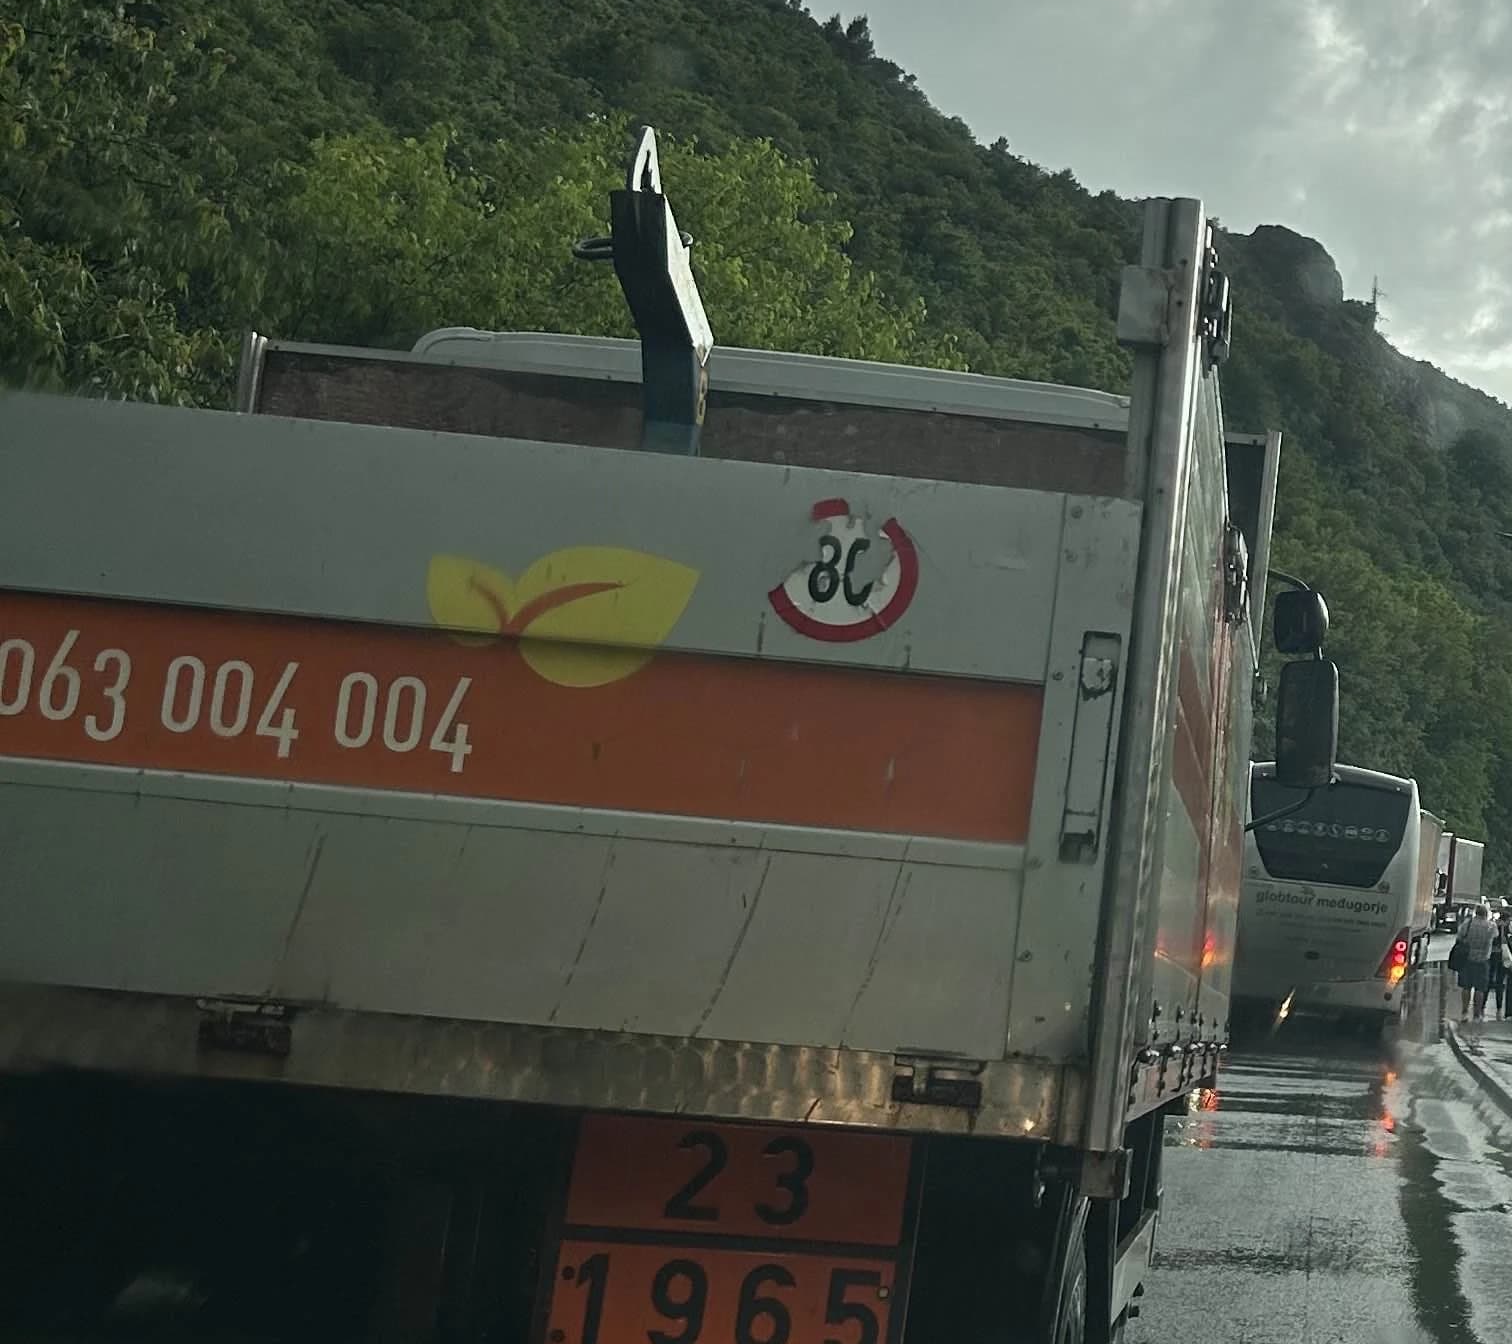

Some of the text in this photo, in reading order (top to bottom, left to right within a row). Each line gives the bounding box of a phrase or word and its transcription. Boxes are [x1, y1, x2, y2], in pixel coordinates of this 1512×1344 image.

[0, 629, 473, 774] 063 004 004
[1255, 889, 1314, 905] globtour
[663, 1130, 815, 1225] 23
